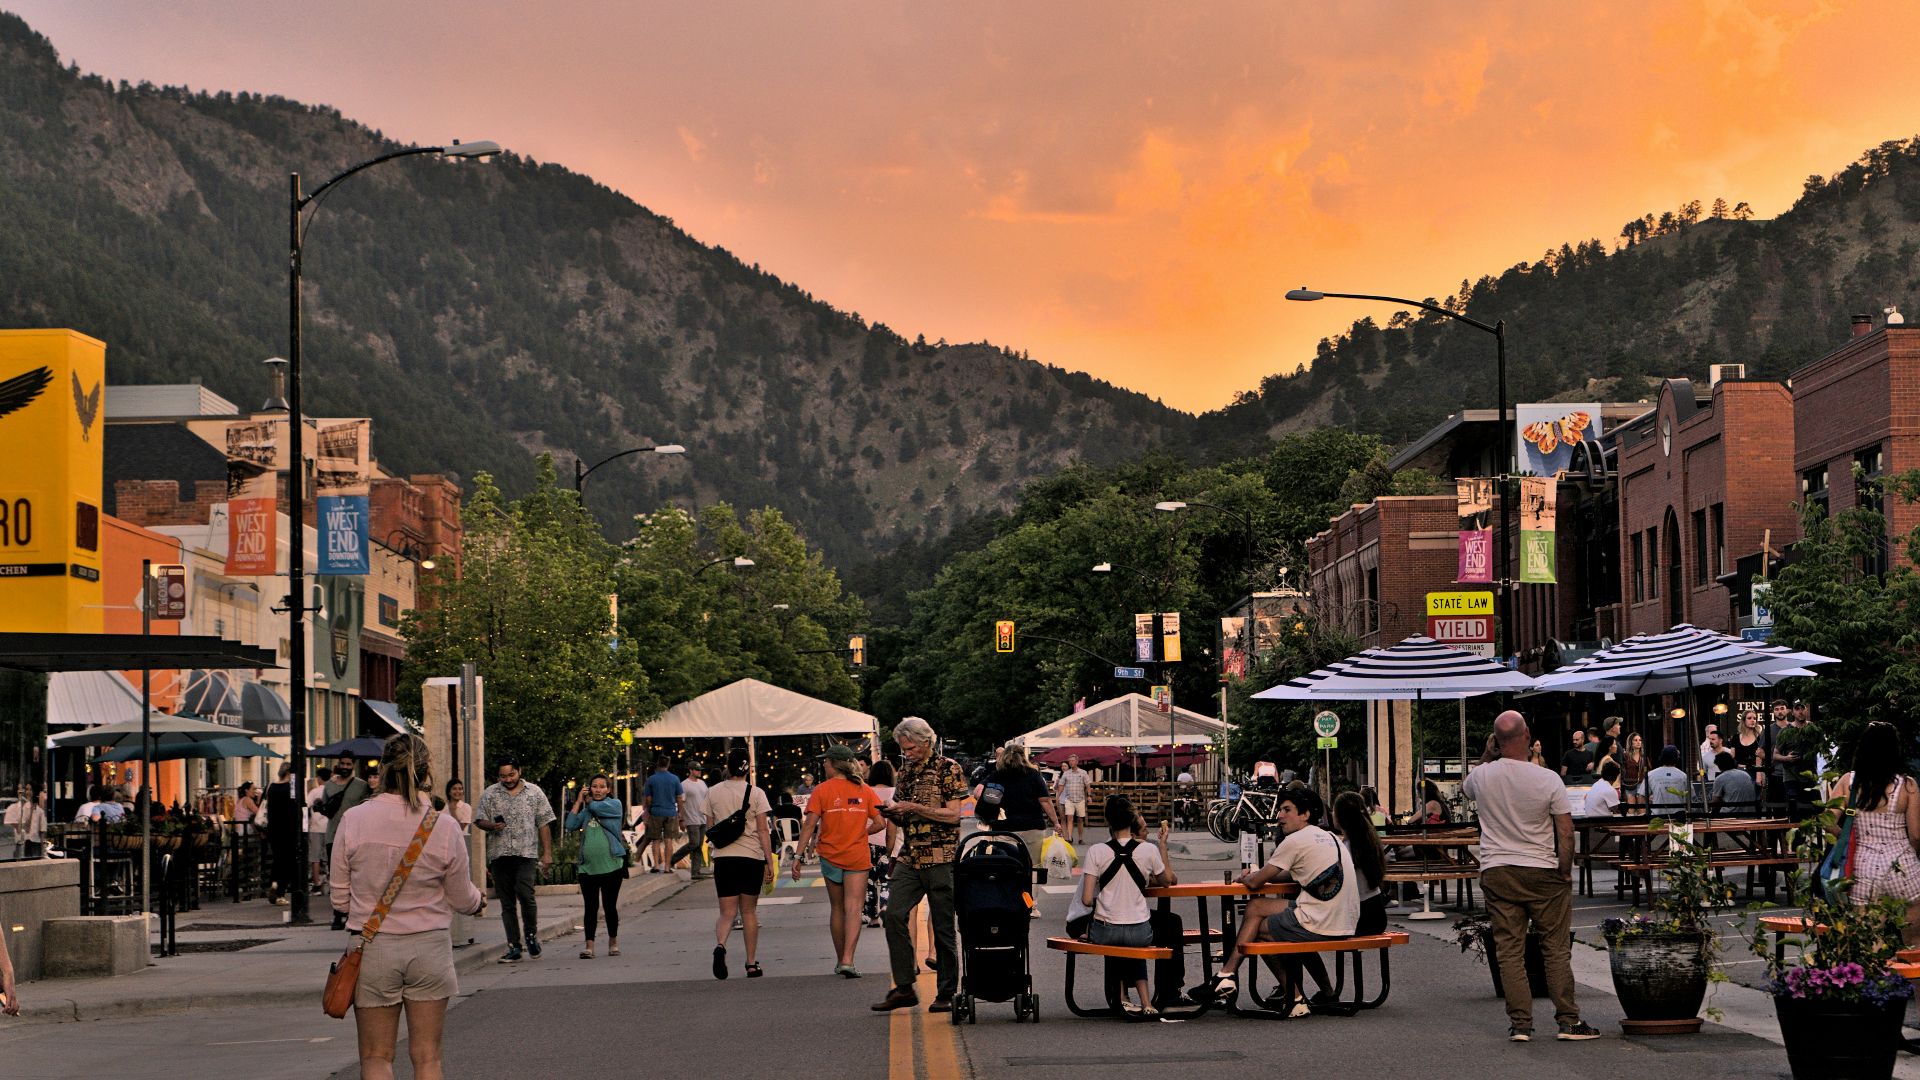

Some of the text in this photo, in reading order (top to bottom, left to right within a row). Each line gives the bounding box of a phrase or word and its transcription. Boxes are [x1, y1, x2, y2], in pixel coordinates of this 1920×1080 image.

[236, 513, 268, 532] WEST
[326, 511, 359, 530] WEST
[237, 533, 266, 553] END
[328, 531, 359, 552] END
[1465, 541, 1487, 554] WEST
[1527, 541, 1548, 554] WEST
[328, 552, 359, 561] DOWNTOWN
[1466, 554, 1485, 568] END
[1528, 554, 1548, 568] END
[1433, 598, 1488, 609] STATE LAW
[1438, 621, 1485, 637] YIELD
[1737, 701, 1774, 711] TENT
